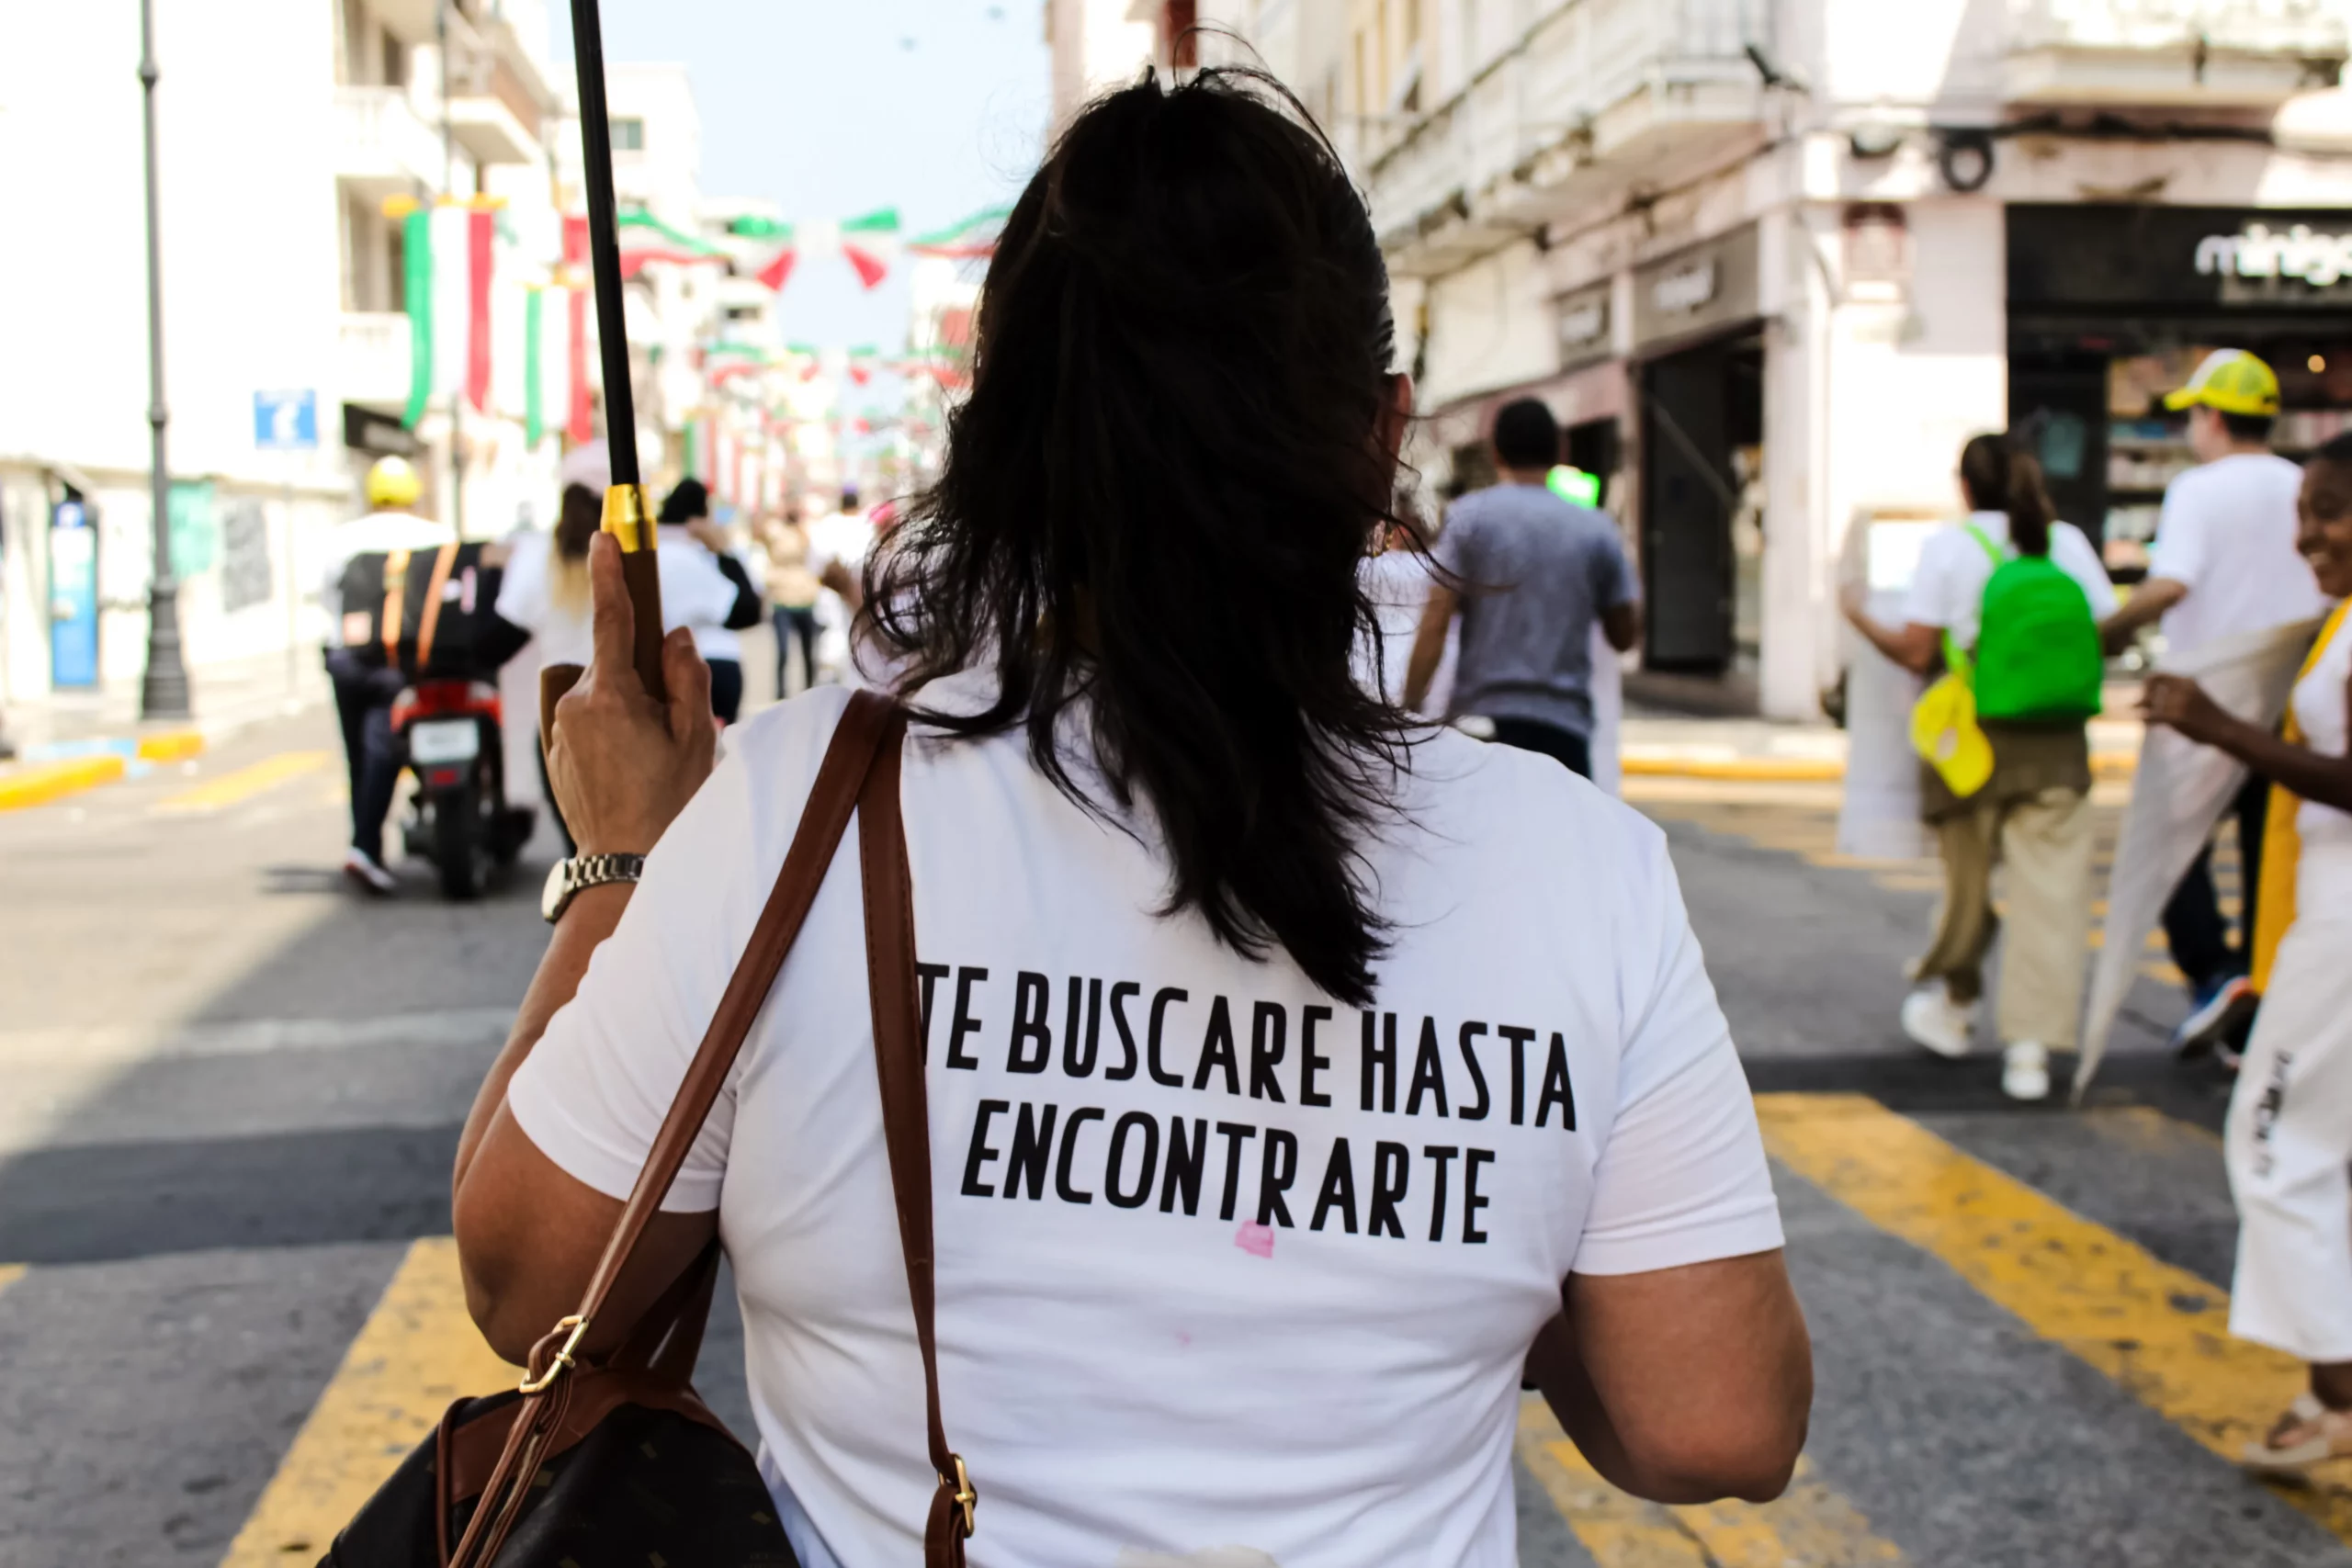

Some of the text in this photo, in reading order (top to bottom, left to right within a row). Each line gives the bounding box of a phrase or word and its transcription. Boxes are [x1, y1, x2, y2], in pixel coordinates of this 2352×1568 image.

[915, 962, 1577, 1133] TE BUSCARE HASTA
[960, 1099, 1496, 1244] ENCONTRARTE
